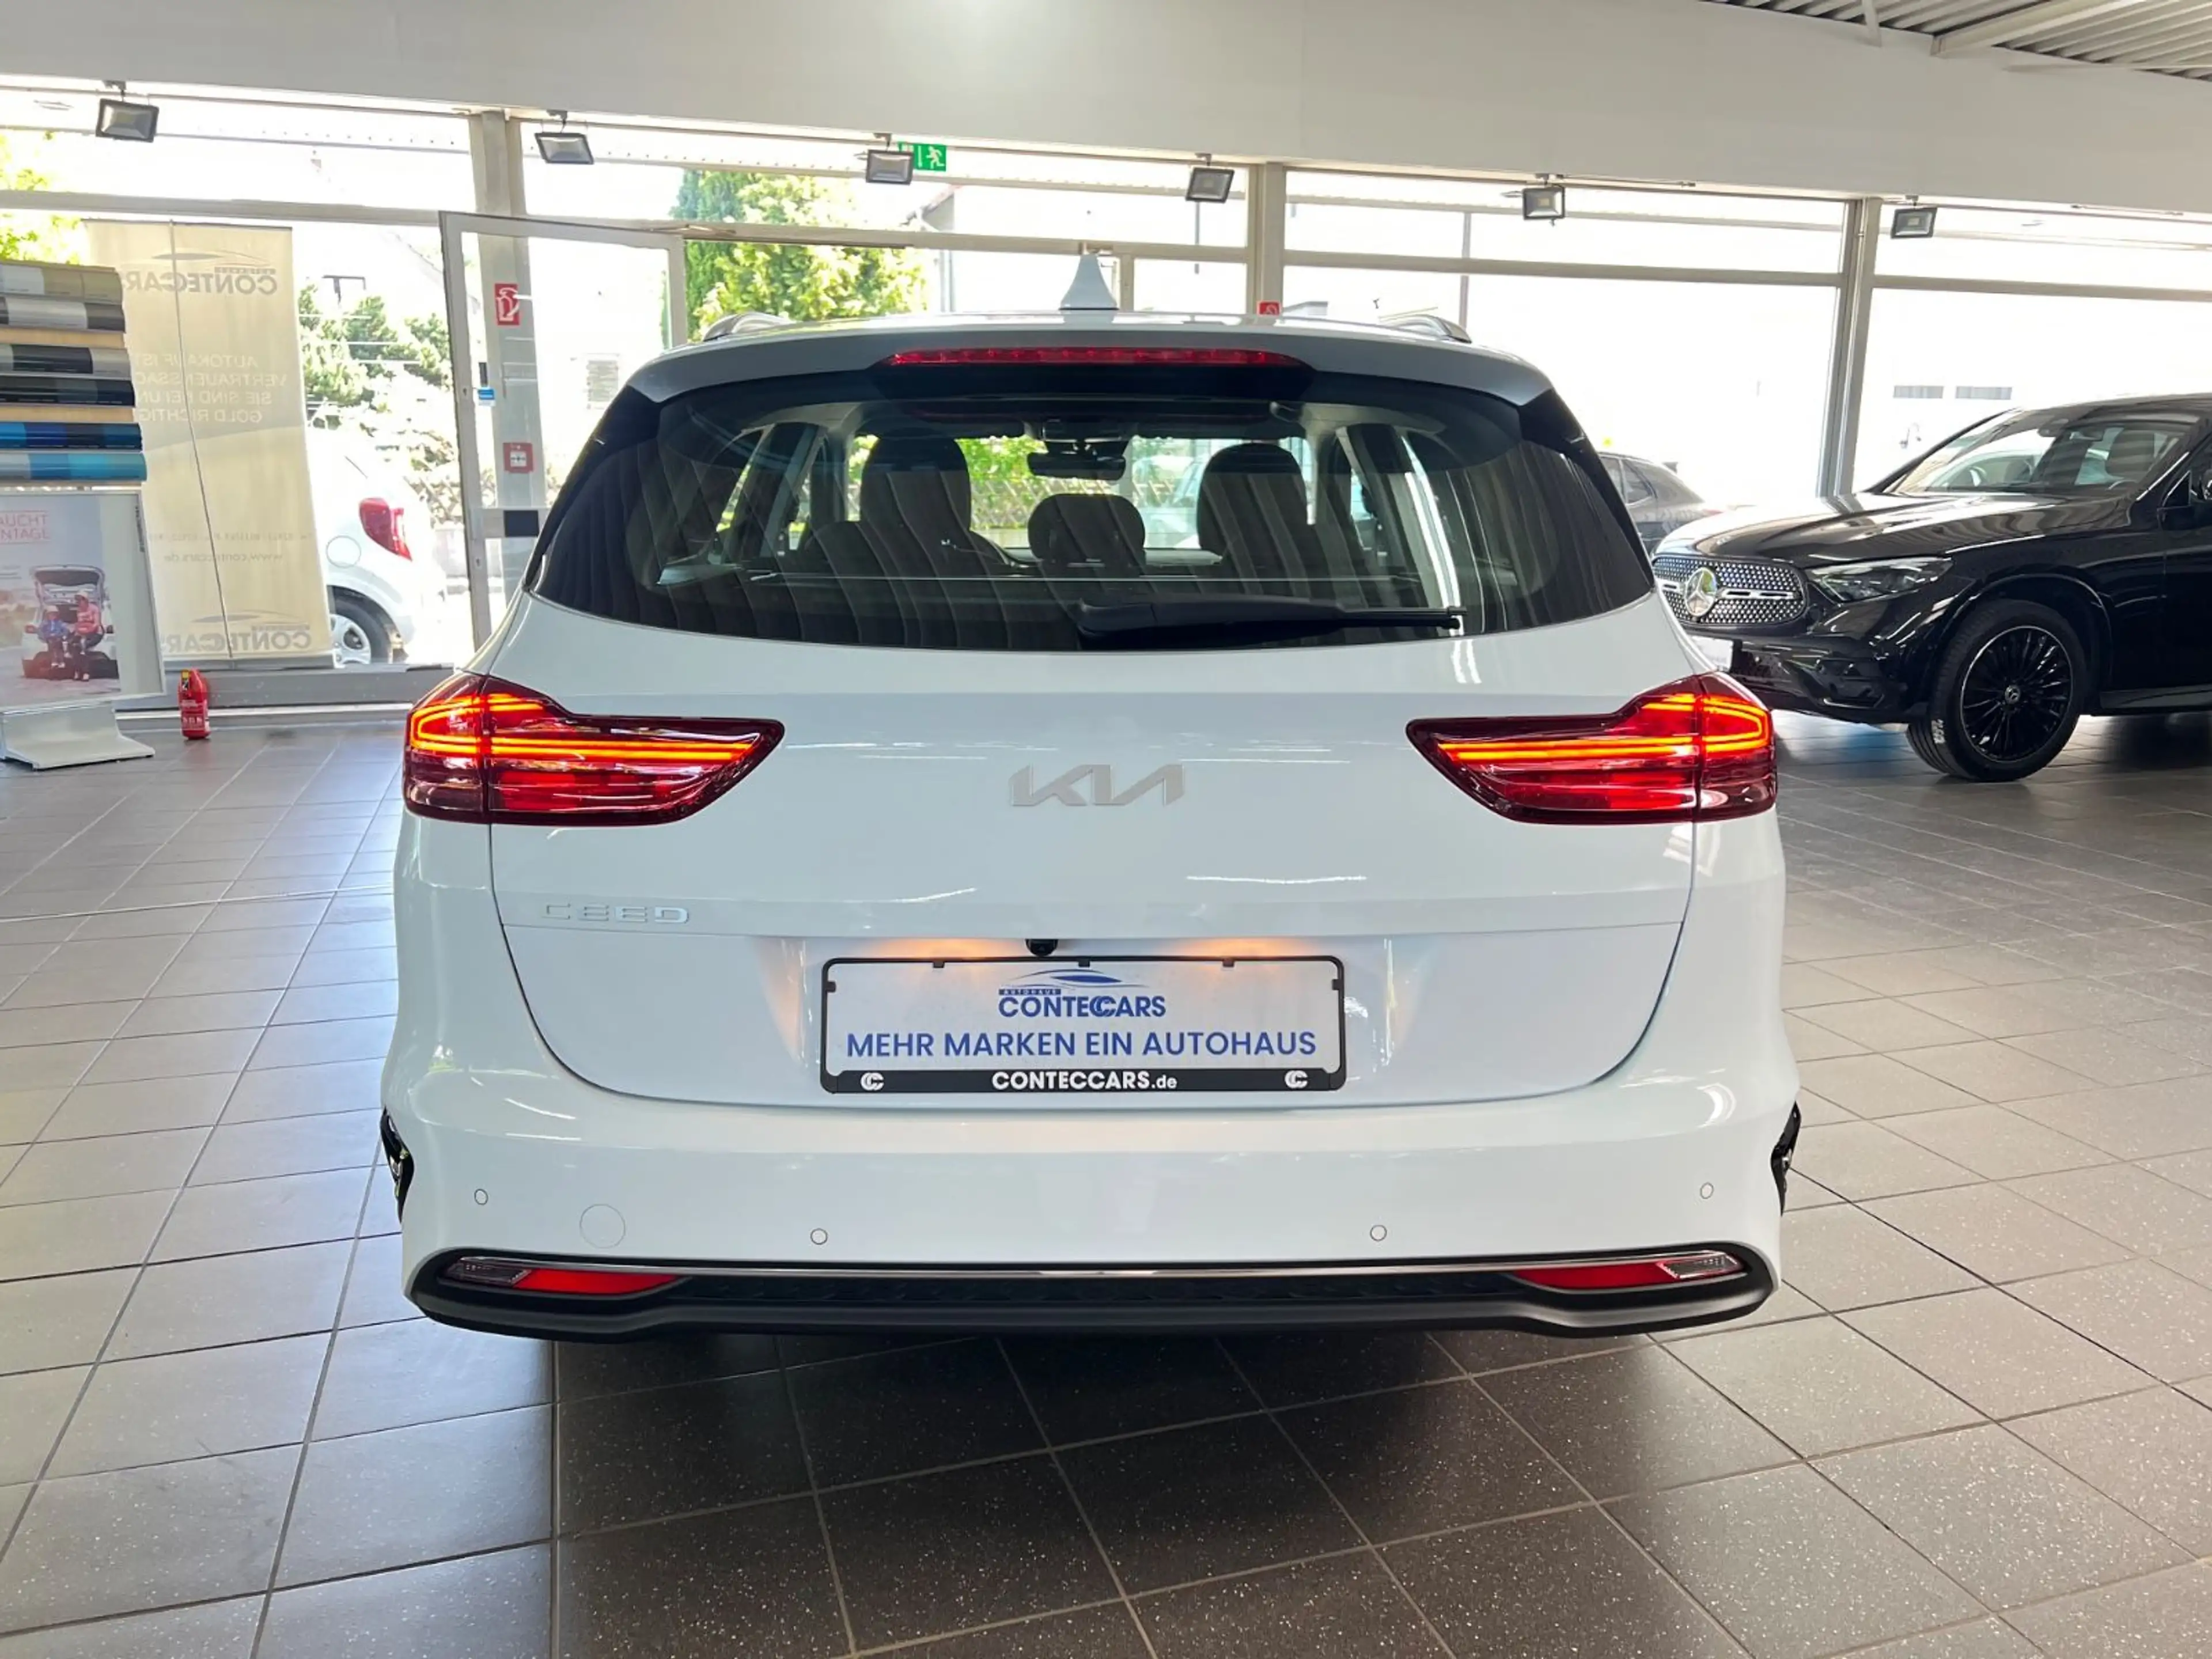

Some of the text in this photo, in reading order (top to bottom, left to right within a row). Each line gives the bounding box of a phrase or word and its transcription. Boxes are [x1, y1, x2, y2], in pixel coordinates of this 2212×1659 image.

[1008, 763, 1186, 806] KIA
[540, 902, 690, 924] CEED
[847, 1031, 1317, 1058] MEHR MARKEN EIN AUTOHAUS
[991, 1070, 1178, 1090] CONTECCARS.de
